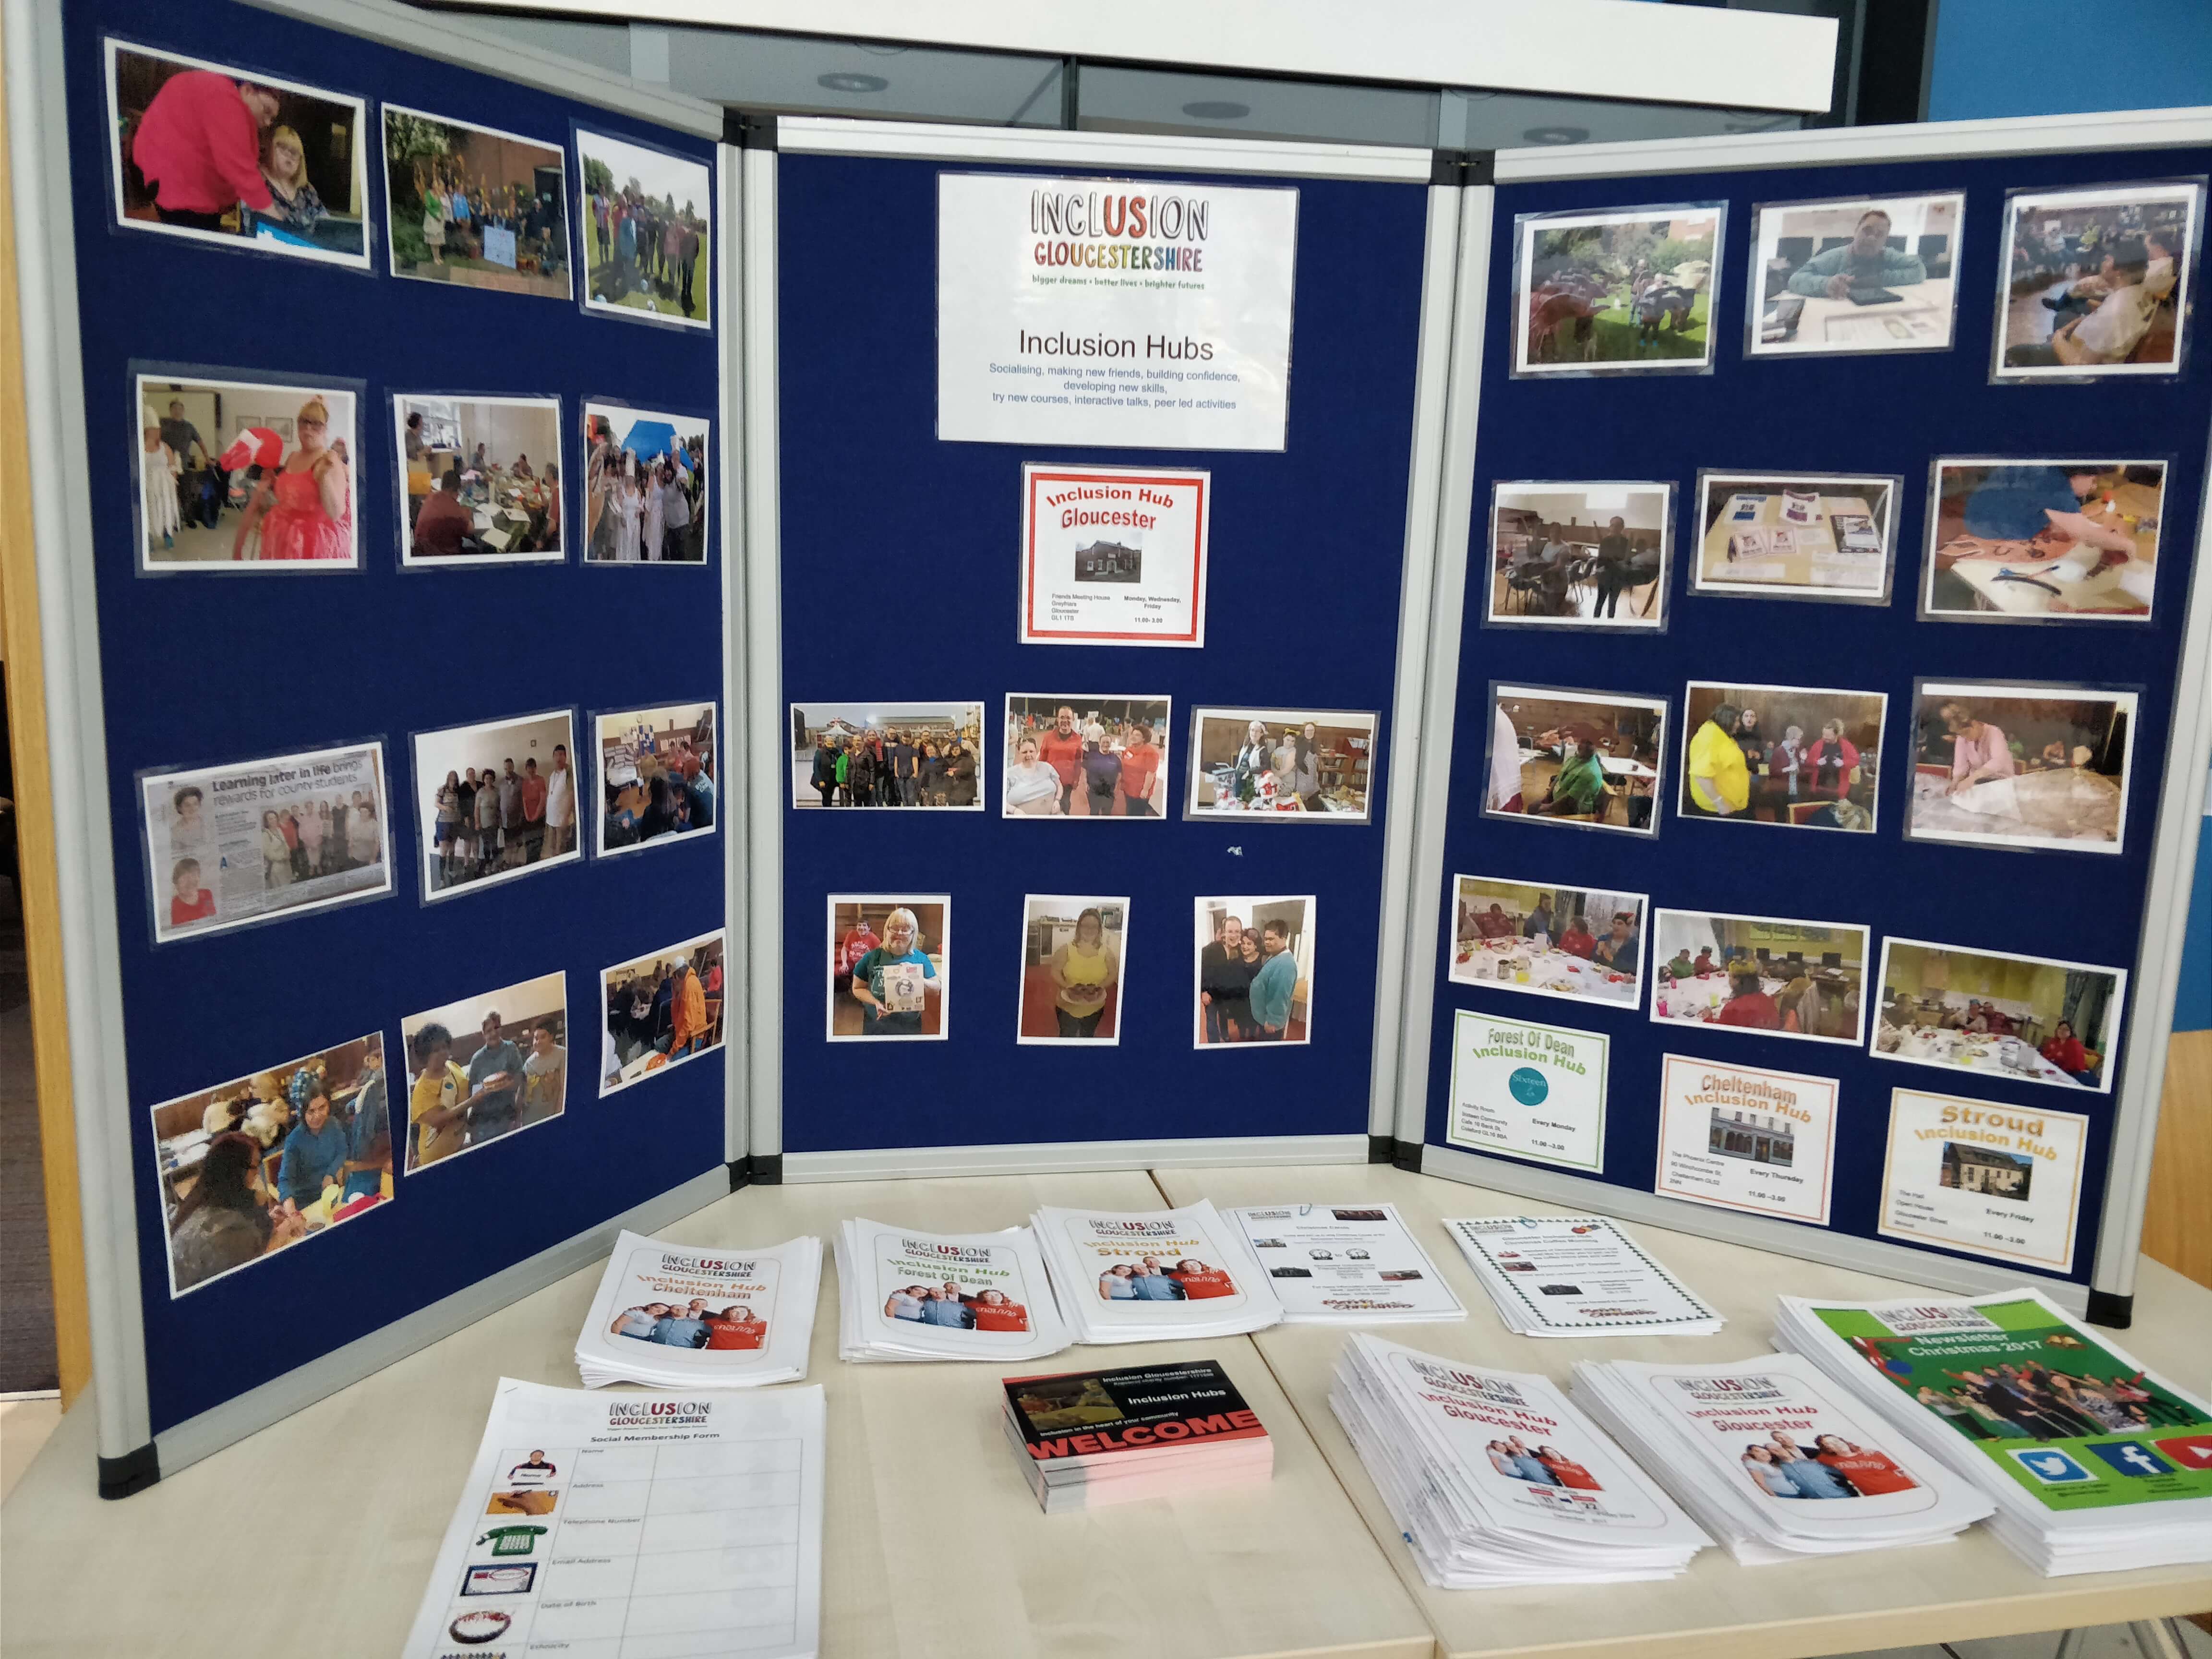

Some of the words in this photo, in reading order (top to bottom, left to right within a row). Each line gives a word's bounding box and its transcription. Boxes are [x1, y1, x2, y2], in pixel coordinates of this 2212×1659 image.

[1031, 190, 1209, 240] INCLUSION
[1034, 241, 1203, 272] GLOUCESTERSHIRE
[1032, 275, 1057, 285] bigger
[1059, 276, 1087, 286] dreams
[1094, 277, 1118, 287] better
[1120, 278, 1137, 287] lives
[1145, 279, 1175, 289] brighter
[1178, 281, 1204, 290] futures
[1020, 329, 1135, 358] Inclusion
[1147, 335, 1214, 361] Hubs
[989, 363, 1045, 376] Socialising,
[1048, 365, 1082, 379] making
[1085, 369, 1106, 378] new
[1108, 367, 1143, 379] friends,
[1146, 370, 1183, 382] building
[1187, 370, 1240, 383] confidence,
[1063, 381, 1116, 393] developing
[1118, 384, 1138, 393] new
[1141, 383, 1167, 394] skills,
[992, 393, 1005, 404] try
[1008, 394, 1028, 403] new
[1031, 395, 1071, 406] courses,
[1074, 395, 1124, 406] interactive
[1126, 396, 1151, 408] talks,
[1154, 398, 1176, 409] peer
[1178, 397, 1193, 408] led
[1196, 398, 1236, 409] activities
[1046, 486, 1131, 507] Inclusion
[1139, 489, 1174, 508] Hub
[1061, 507, 1156, 530] Gloucester
[212, 774, 266, 792] Learning
[300, 768, 311, 778] in
[312, 764, 331, 776] life
[1488, 1028, 1523, 1045] Forest
[1528, 1031, 1541, 1048] Of
[1544, 1034, 1575, 1058] Dean
[1473, 1046, 1548, 1063] Inclusion
[1553, 1055, 1586, 1075] Hub
[1512, 1073, 1546, 1087] Sixteen
[1702, 1074, 1796, 1105] Cheltenham
[1684, 1092, 1769, 1110] Inclusion
[1776, 1105, 1812, 1123] Hub
[1532, 1118, 1550, 1127] Every
[1551, 1121, 1575, 1132] Monday
[1941, 1106, 2045, 1137] Stroud
[1914, 1125, 2010, 1146] Inclusion
[2017, 1138, 2057, 1161] Hub
[1750, 1168, 1769, 1178] Every
[1771, 1172, 1803, 1184] Thursday
[1986, 1208, 2008, 1218] Every
[2009, 1212, 2034, 1223] Friday
[1089, 1219, 1175, 1232] INCLUSION
[902, 1238, 991, 1257] INCLUSION
[1083, 1240, 1160, 1248] Inclusion
[1098, 1248, 1182, 1257] Stroud
[661, 1253, 757, 1271] INCLUSION
[905, 1248, 990, 1263] GLOUCESTERSHIRE
[661, 1264, 752, 1278] GLOUCESTERSHIRE
[887, 1258, 968, 1274] Inclusion
[975, 1267, 1010, 1277] Hub
[898, 1266, 937, 1279] Forest
[941, 1273, 955, 1282] Of
[960, 1274, 992, 1286] Dean
[636, 1274, 723, 1288] Inclusion
[731, 1282, 767, 1292] Hub
[651, 1282, 751, 1300] Cheltenham
[1908, 1342, 2000, 1356] Christmas
[2005, 1341, 2044, 1353] 2017
[1916, 1333, 2008, 1346] Newsletter
[1103, 1374, 1143, 1383] Inclusion
[1144, 1368, 1212, 1379] Gloucestershire
[1407, 1358, 1522, 1397] INCLUSION
[1674, 1377, 1777, 1393] INCLUSION
[1128, 1394, 1189, 1406] Inclusion
[1192, 1389, 1226, 1399] Hubs
[609, 1401, 712, 1417] INCLUSION
[1418, 1391, 1510, 1416] Inclusion
[1514, 1409, 1558, 1427] Hub
[1686, 1407, 1770, 1419] Inclusion
[1776, 1405, 1818, 1414] Hub
[610, 1416, 707, 1426] GLOUCESTERSHIRE
[1443, 1405, 1553, 1437] Gloucester
[1712, 1419, 1815, 1432] Gloucester
[624, 1433, 690, 1443] Membership
[1027, 1409, 1260, 1459] WELCOME
